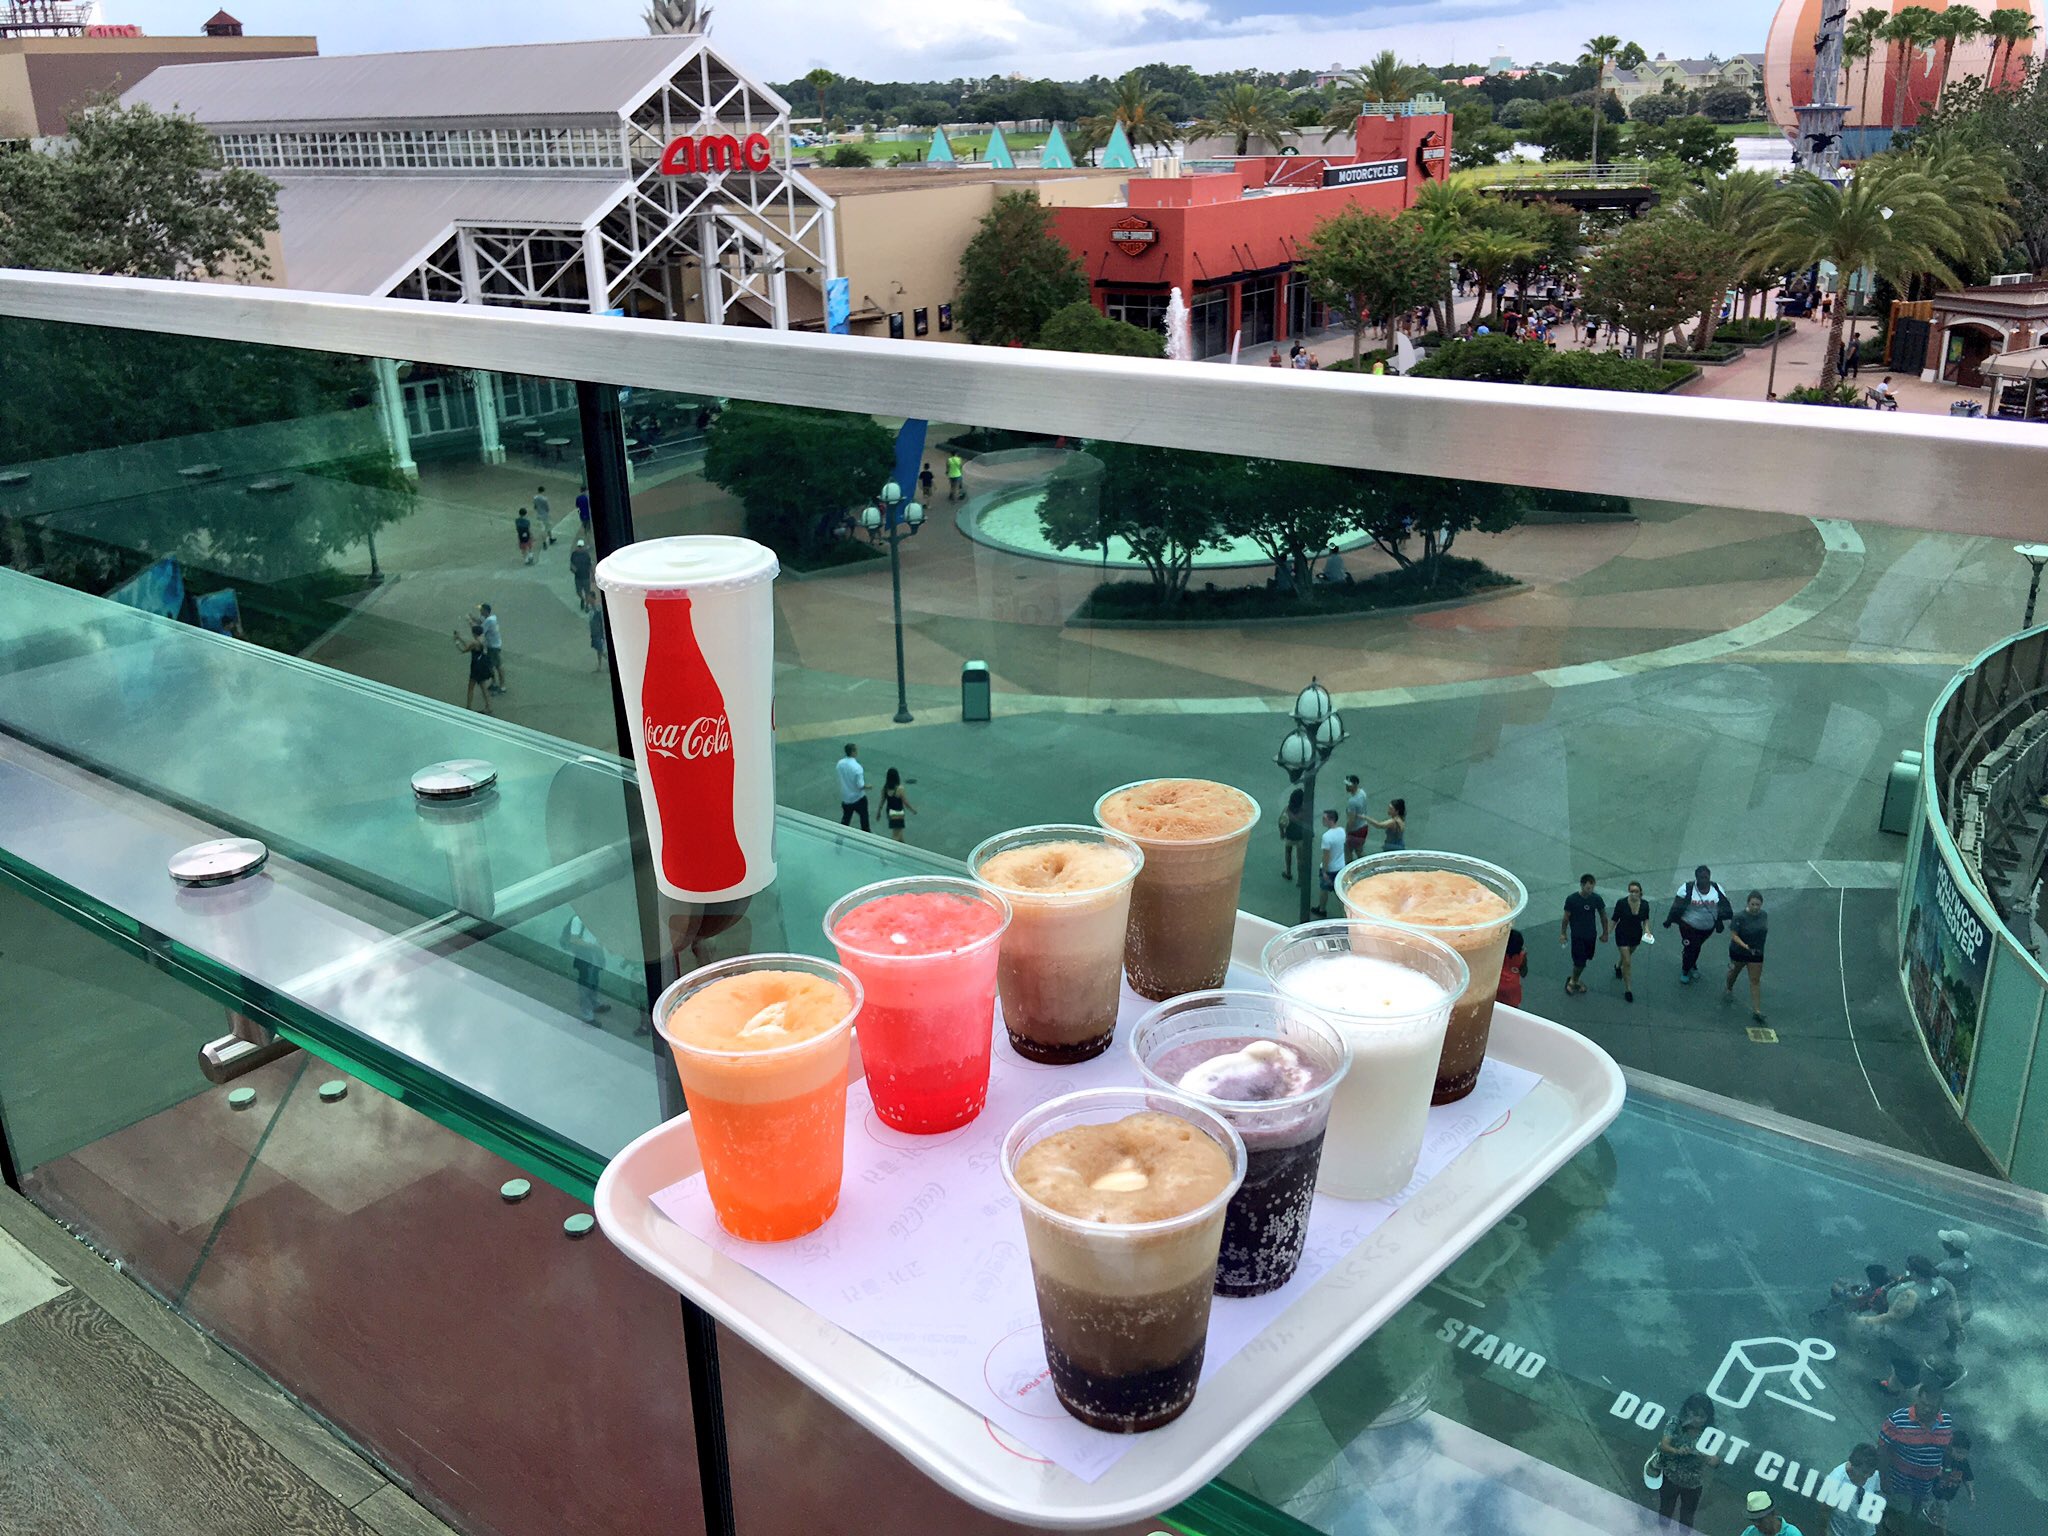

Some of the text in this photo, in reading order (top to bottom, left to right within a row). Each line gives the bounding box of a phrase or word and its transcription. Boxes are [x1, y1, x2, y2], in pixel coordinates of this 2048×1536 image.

[1338, 164, 1399, 183] MOTORCYCLES
[644, 714, 731, 760] Coca-Cola
[1937, 859, 1984, 947] HOLLYWOOD
[1435, 1317, 1547, 1379] STAND
[1609, 1390, 1666, 1431] DO
[1754, 1450, 1888, 1525] CLIMB
